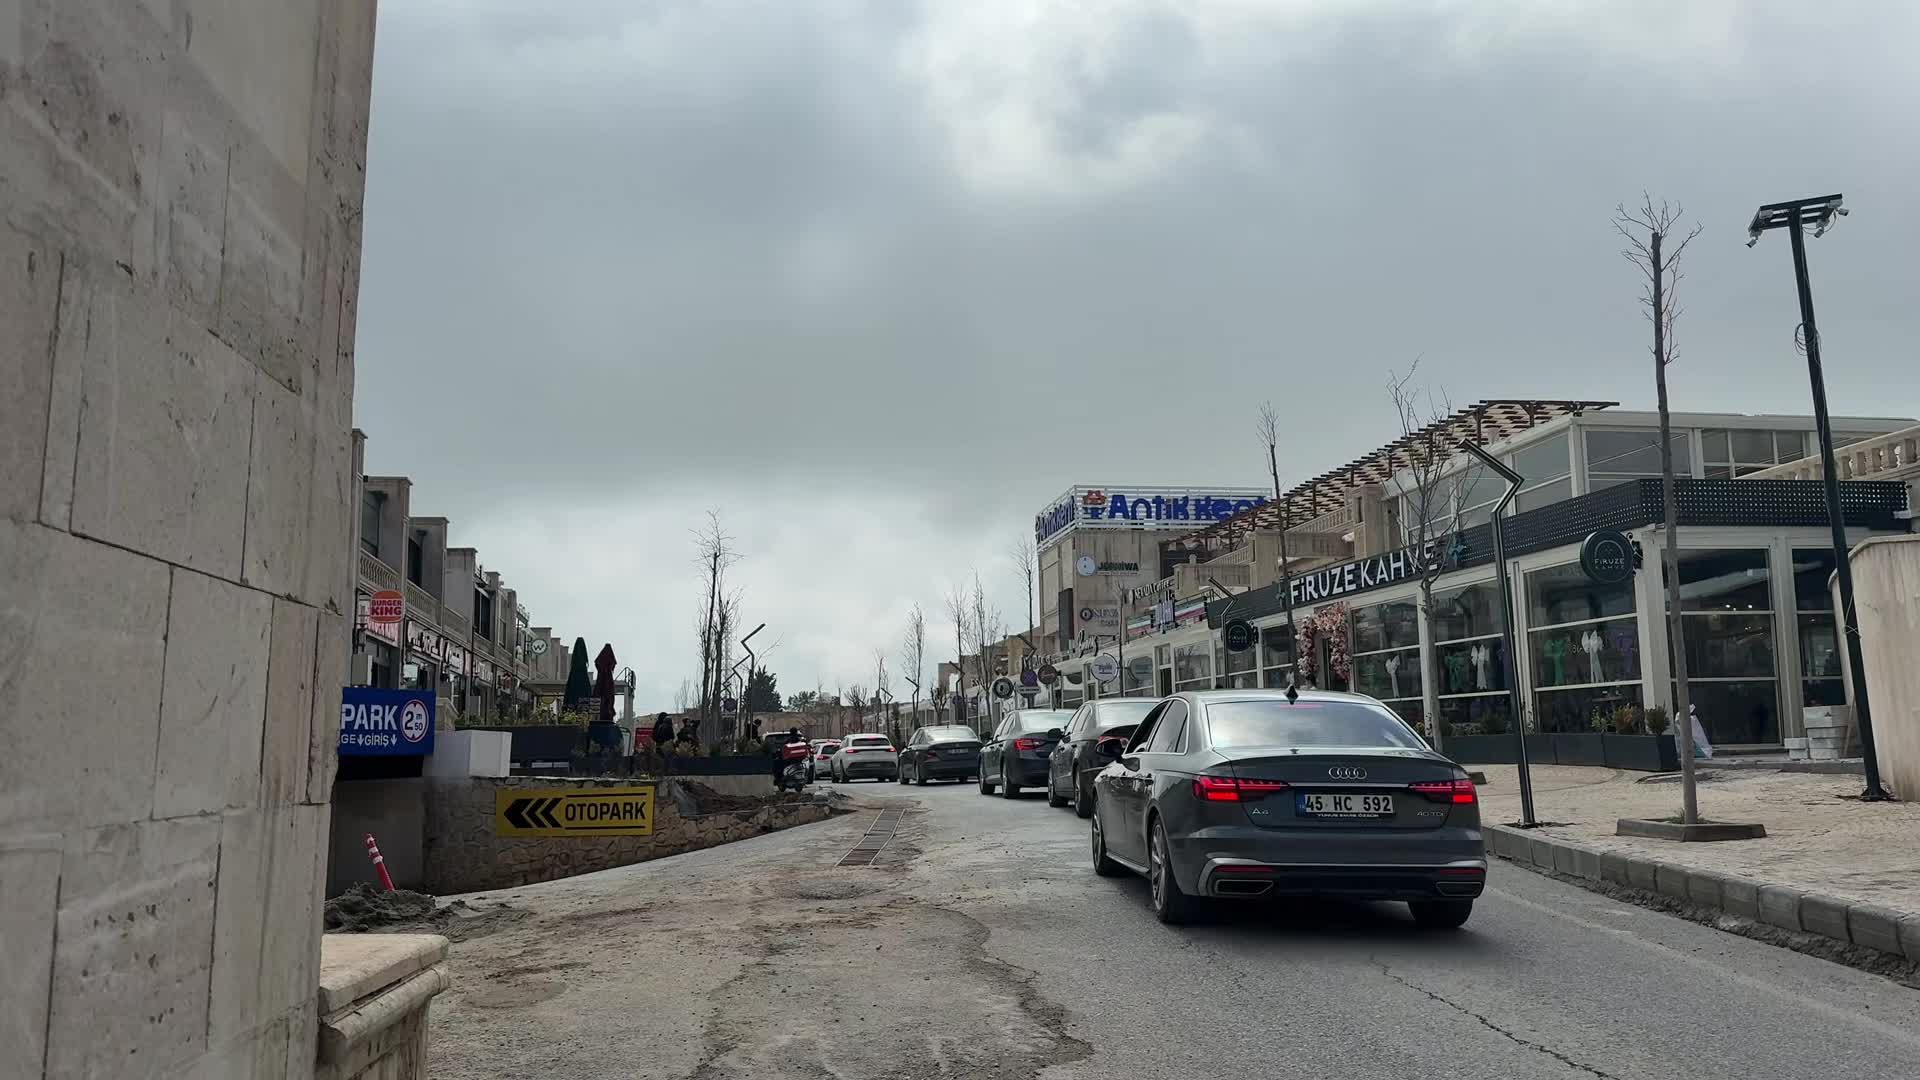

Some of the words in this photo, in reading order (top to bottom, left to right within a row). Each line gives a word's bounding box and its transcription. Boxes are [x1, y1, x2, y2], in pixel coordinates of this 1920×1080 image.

[370, 606, 402, 616] KING
[371, 599, 402, 607] BURGER
[341, 703, 398, 730] PARK
[404, 710, 414, 731] 2
[414, 722, 424, 731] 50
[564, 801, 646, 821] OTOPARK
[1306, 795, 1323, 811] 45
[1333, 795, 1353, 811] HC
[1363, 796, 1391, 812] 592
